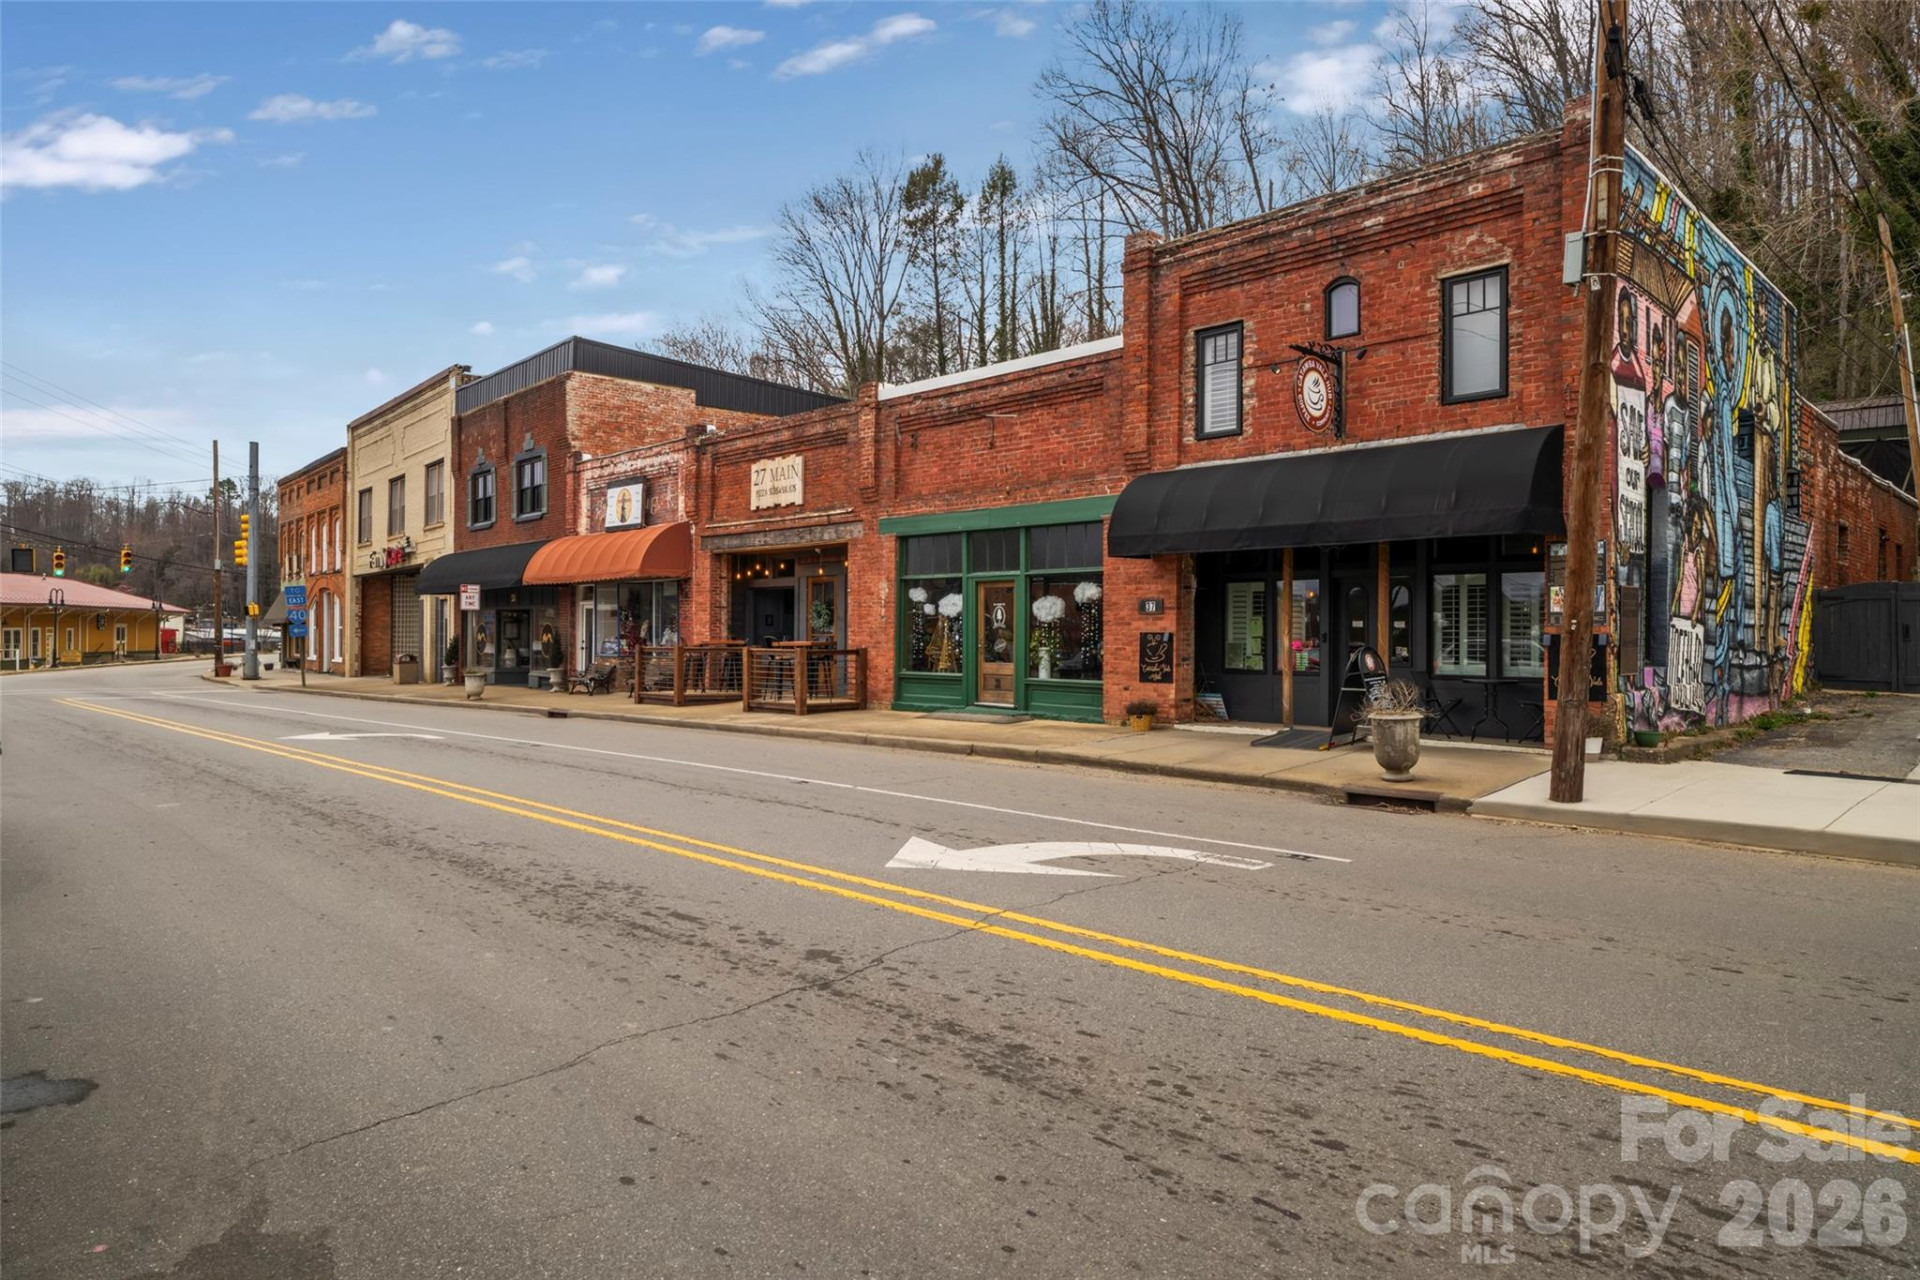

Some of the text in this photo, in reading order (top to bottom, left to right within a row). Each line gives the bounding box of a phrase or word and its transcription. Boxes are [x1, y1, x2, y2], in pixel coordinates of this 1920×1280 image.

[1298, 394, 1311, 423] COFFEE
[753, 464, 799, 487] 27 MAIN
[289, 610, 307, 620] 40
[1145, 601, 1156, 612] 37
